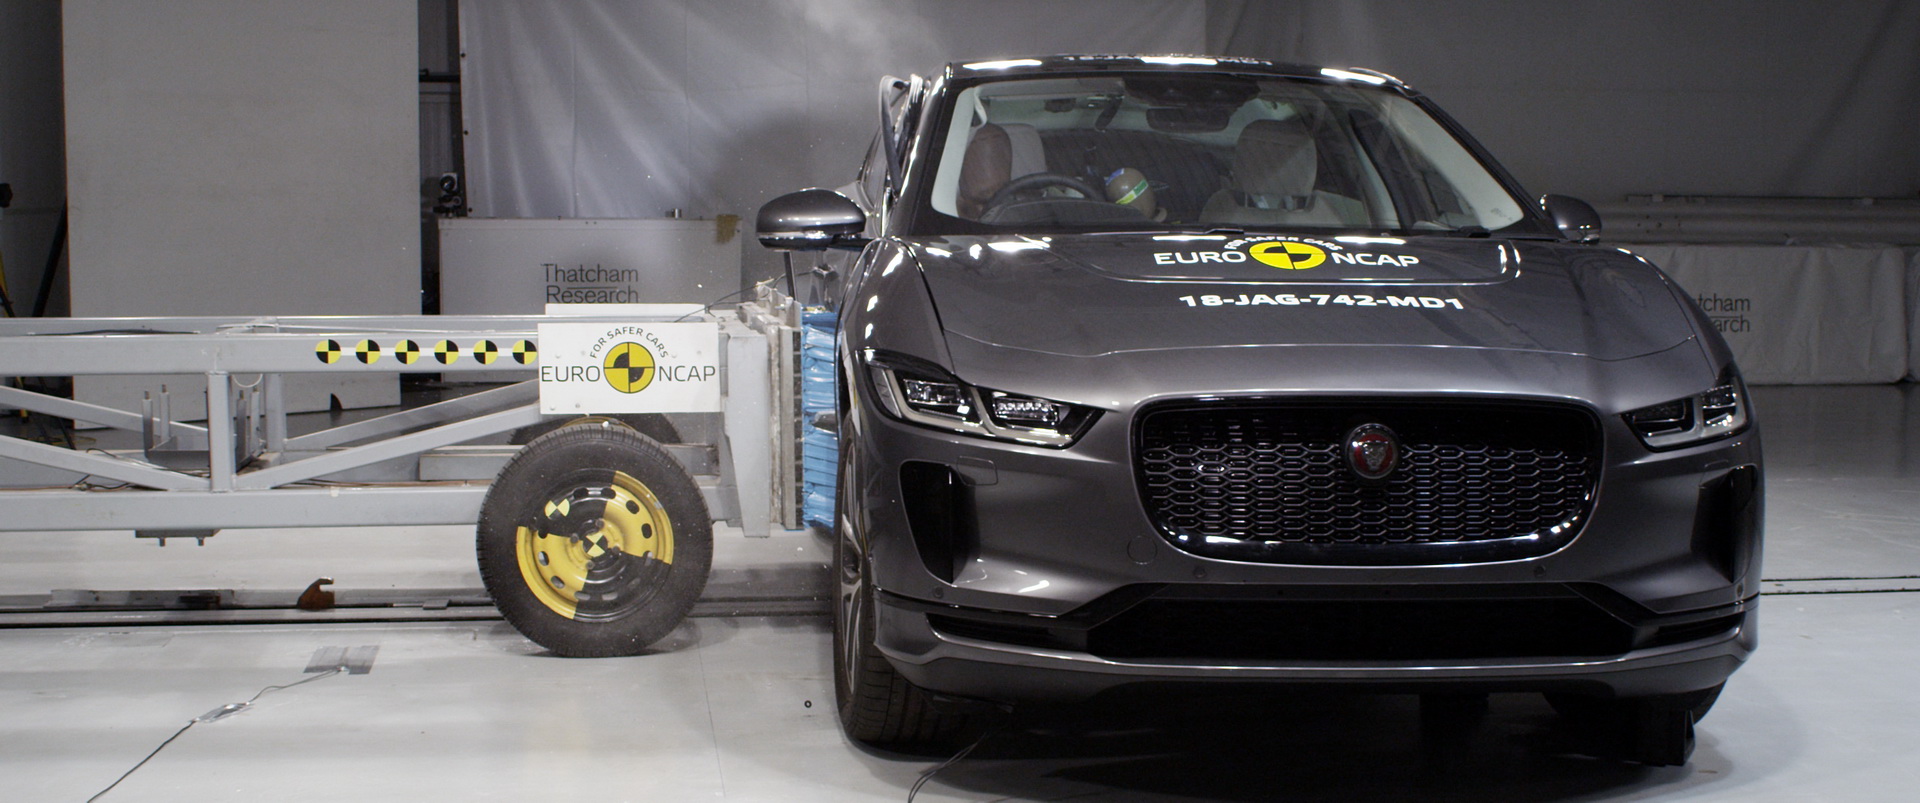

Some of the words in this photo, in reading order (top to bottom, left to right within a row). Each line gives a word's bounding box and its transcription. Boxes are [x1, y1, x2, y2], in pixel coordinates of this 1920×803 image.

[1153, 251, 1247, 265] EURO
[1330, 252, 1420, 267] NCAP
[541, 263, 639, 283] Thatcham
[546, 285, 639, 304] Research
[1179, 293, 1465, 310] 18-JAG-742-MD1
[589, 337, 608, 359] FOR
[606, 326, 644, 340] SAFER
[645, 332, 669, 359] CARS
[541, 365, 602, 383] EURO
[658, 365, 717, 382] NCAP
